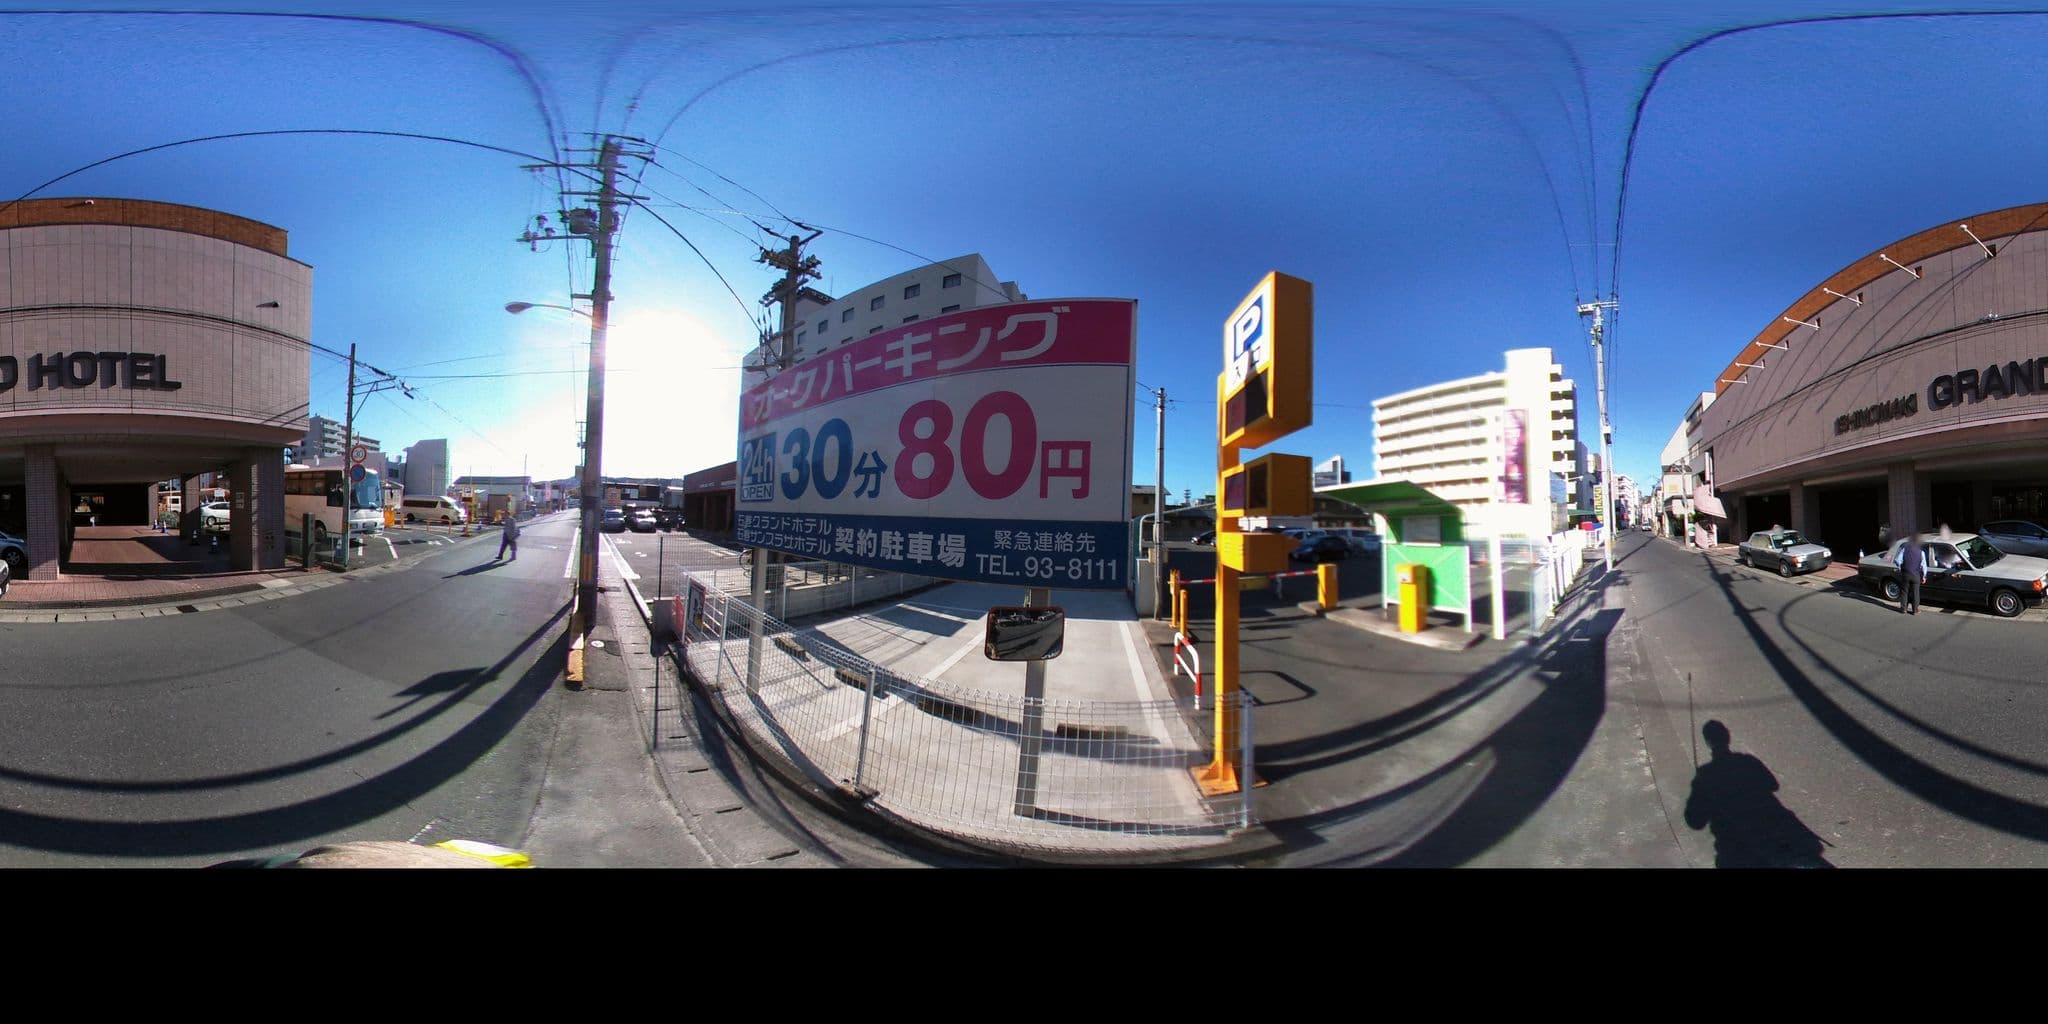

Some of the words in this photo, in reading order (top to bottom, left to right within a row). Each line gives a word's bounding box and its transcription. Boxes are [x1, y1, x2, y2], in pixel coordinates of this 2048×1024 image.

[1235, 304, 1262, 357] P
[27, 351, 182, 392] HOTEL
[752, 305, 1071, 421] オークパーキング
[742, 438, 774, 483] 24h
[742, 484, 773, 499] OPEN
[835, 526, 967, 568] 契約駐車場
[994, 530, 1096, 553] 緊急連絡先
